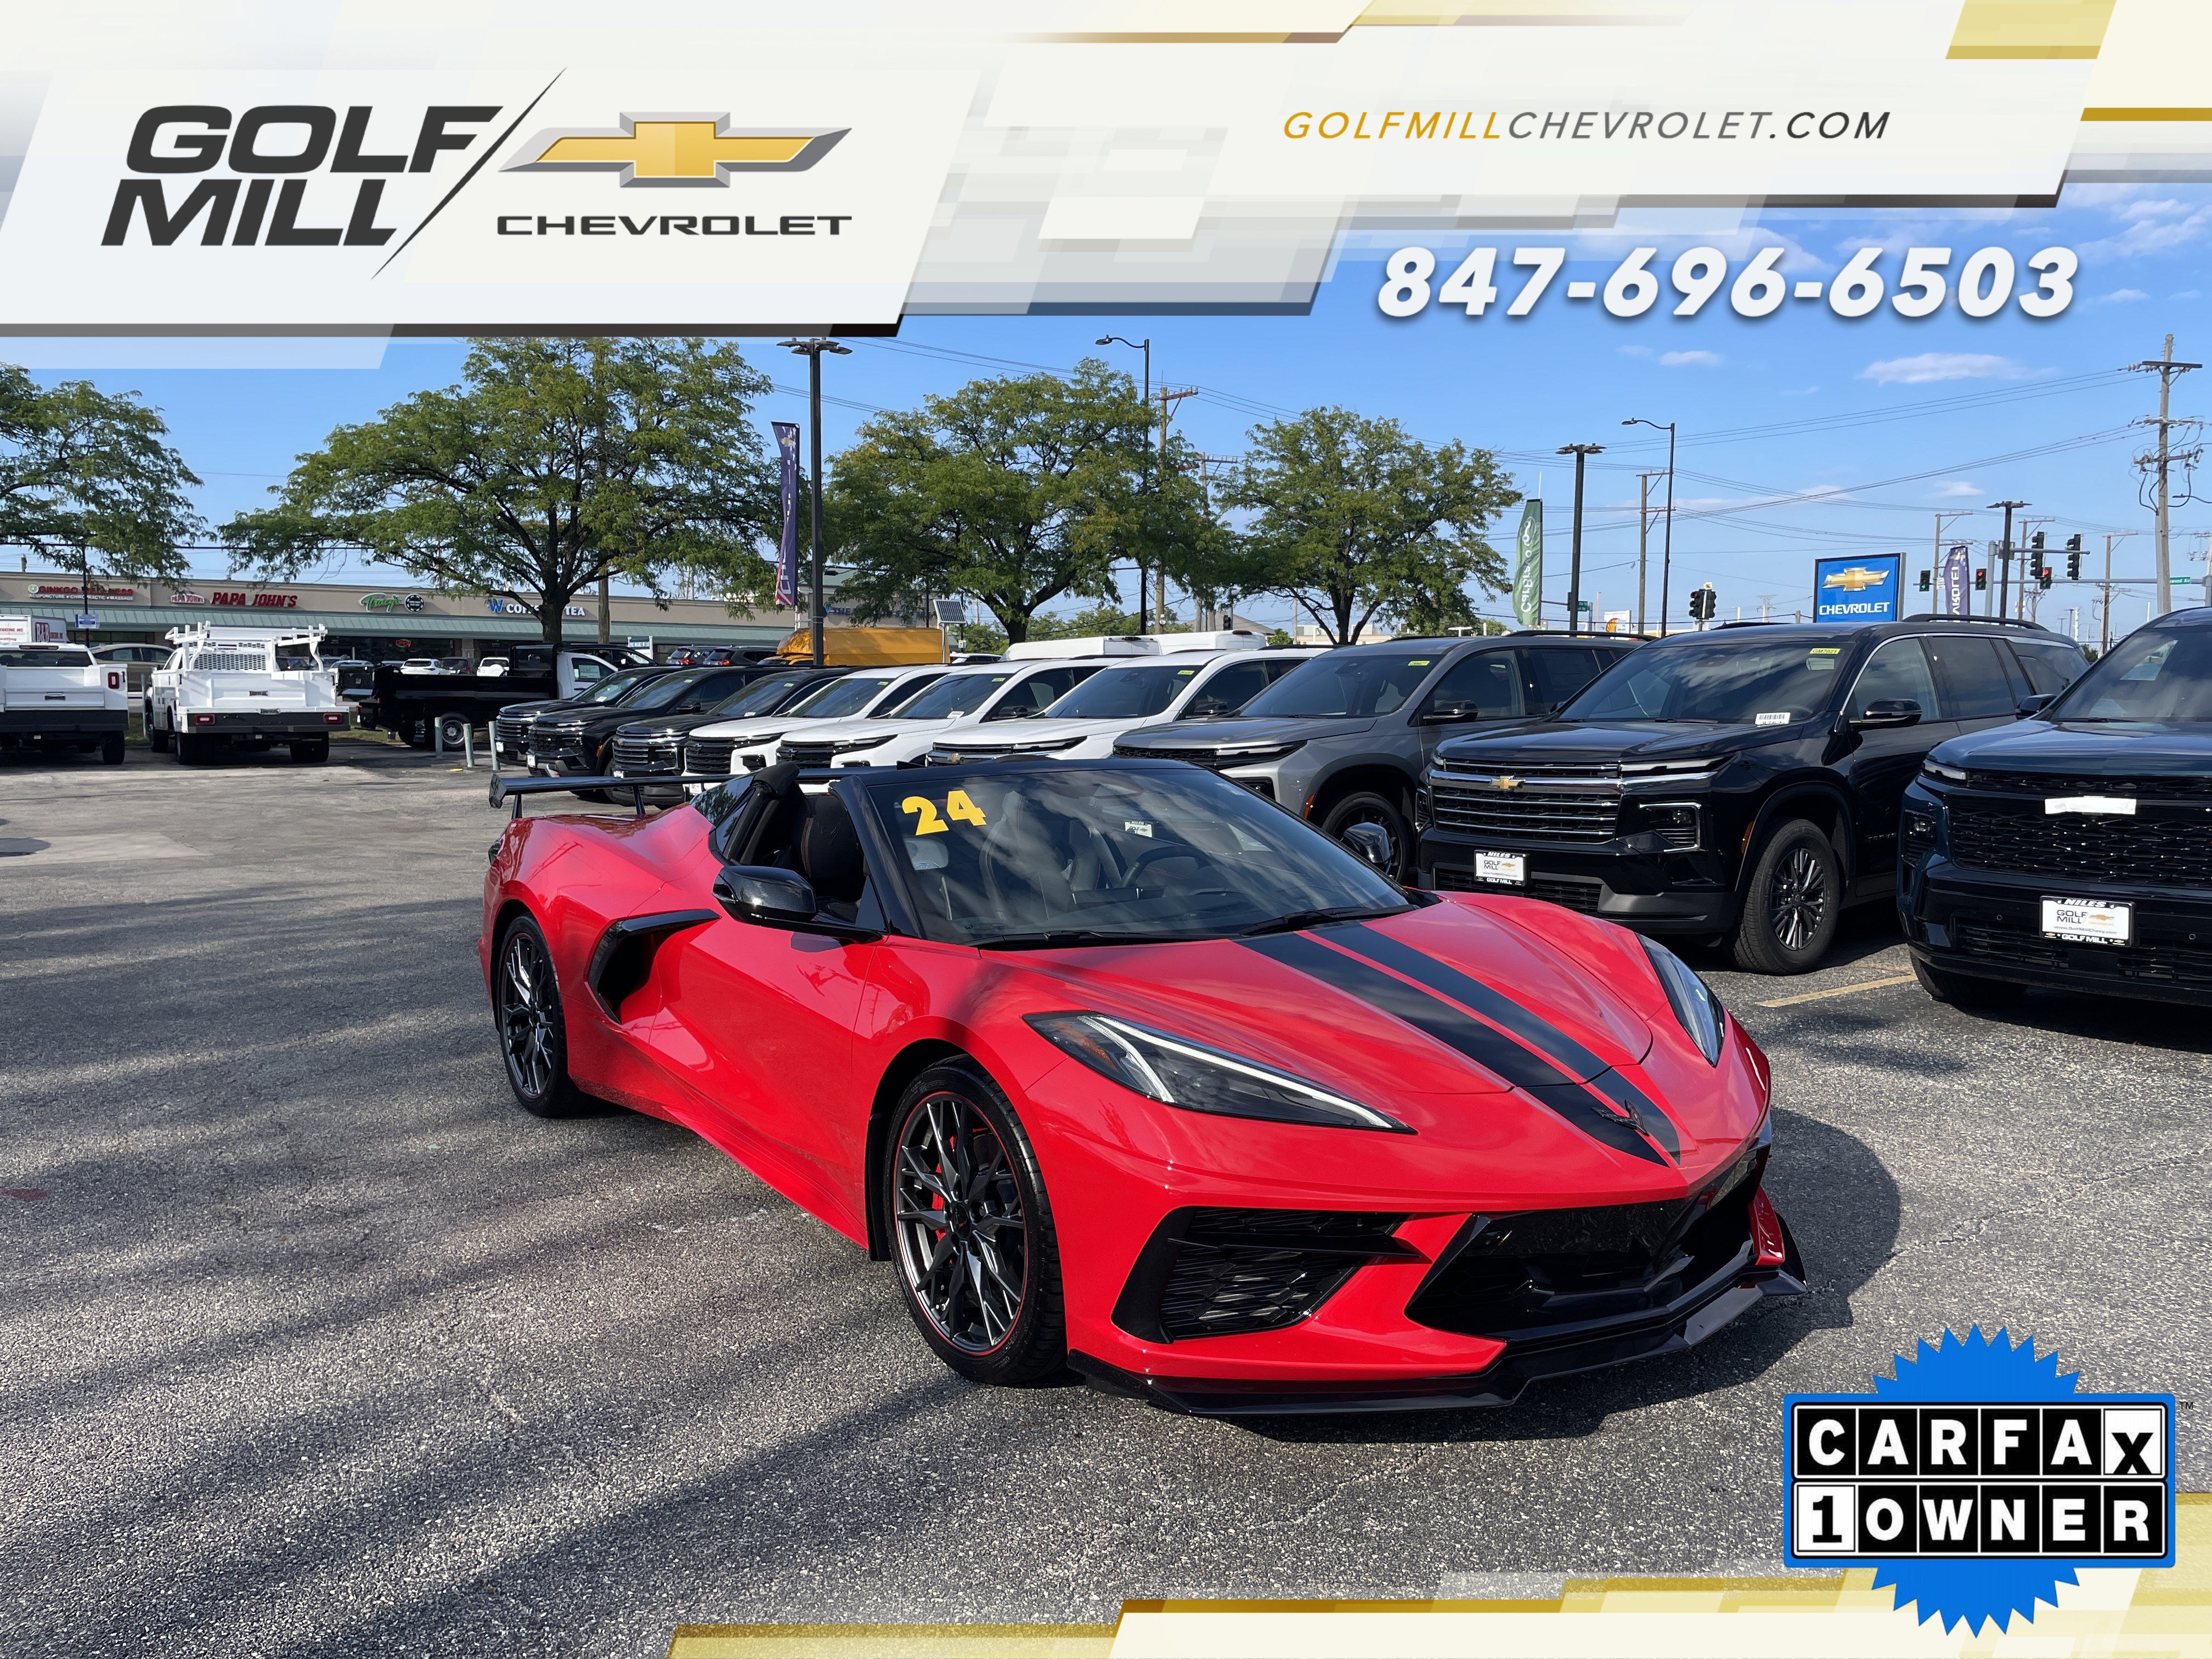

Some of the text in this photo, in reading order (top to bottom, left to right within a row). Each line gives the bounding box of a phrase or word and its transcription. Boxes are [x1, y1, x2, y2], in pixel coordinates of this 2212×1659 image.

[211, 592, 298, 607] PAPA JOHN'S
[565, 606, 585, 616] TEA
[1819, 602, 1890, 616] CHEVROLET
[902, 790, 987, 836] 24
[2064, 899, 2107, 907] NILES
